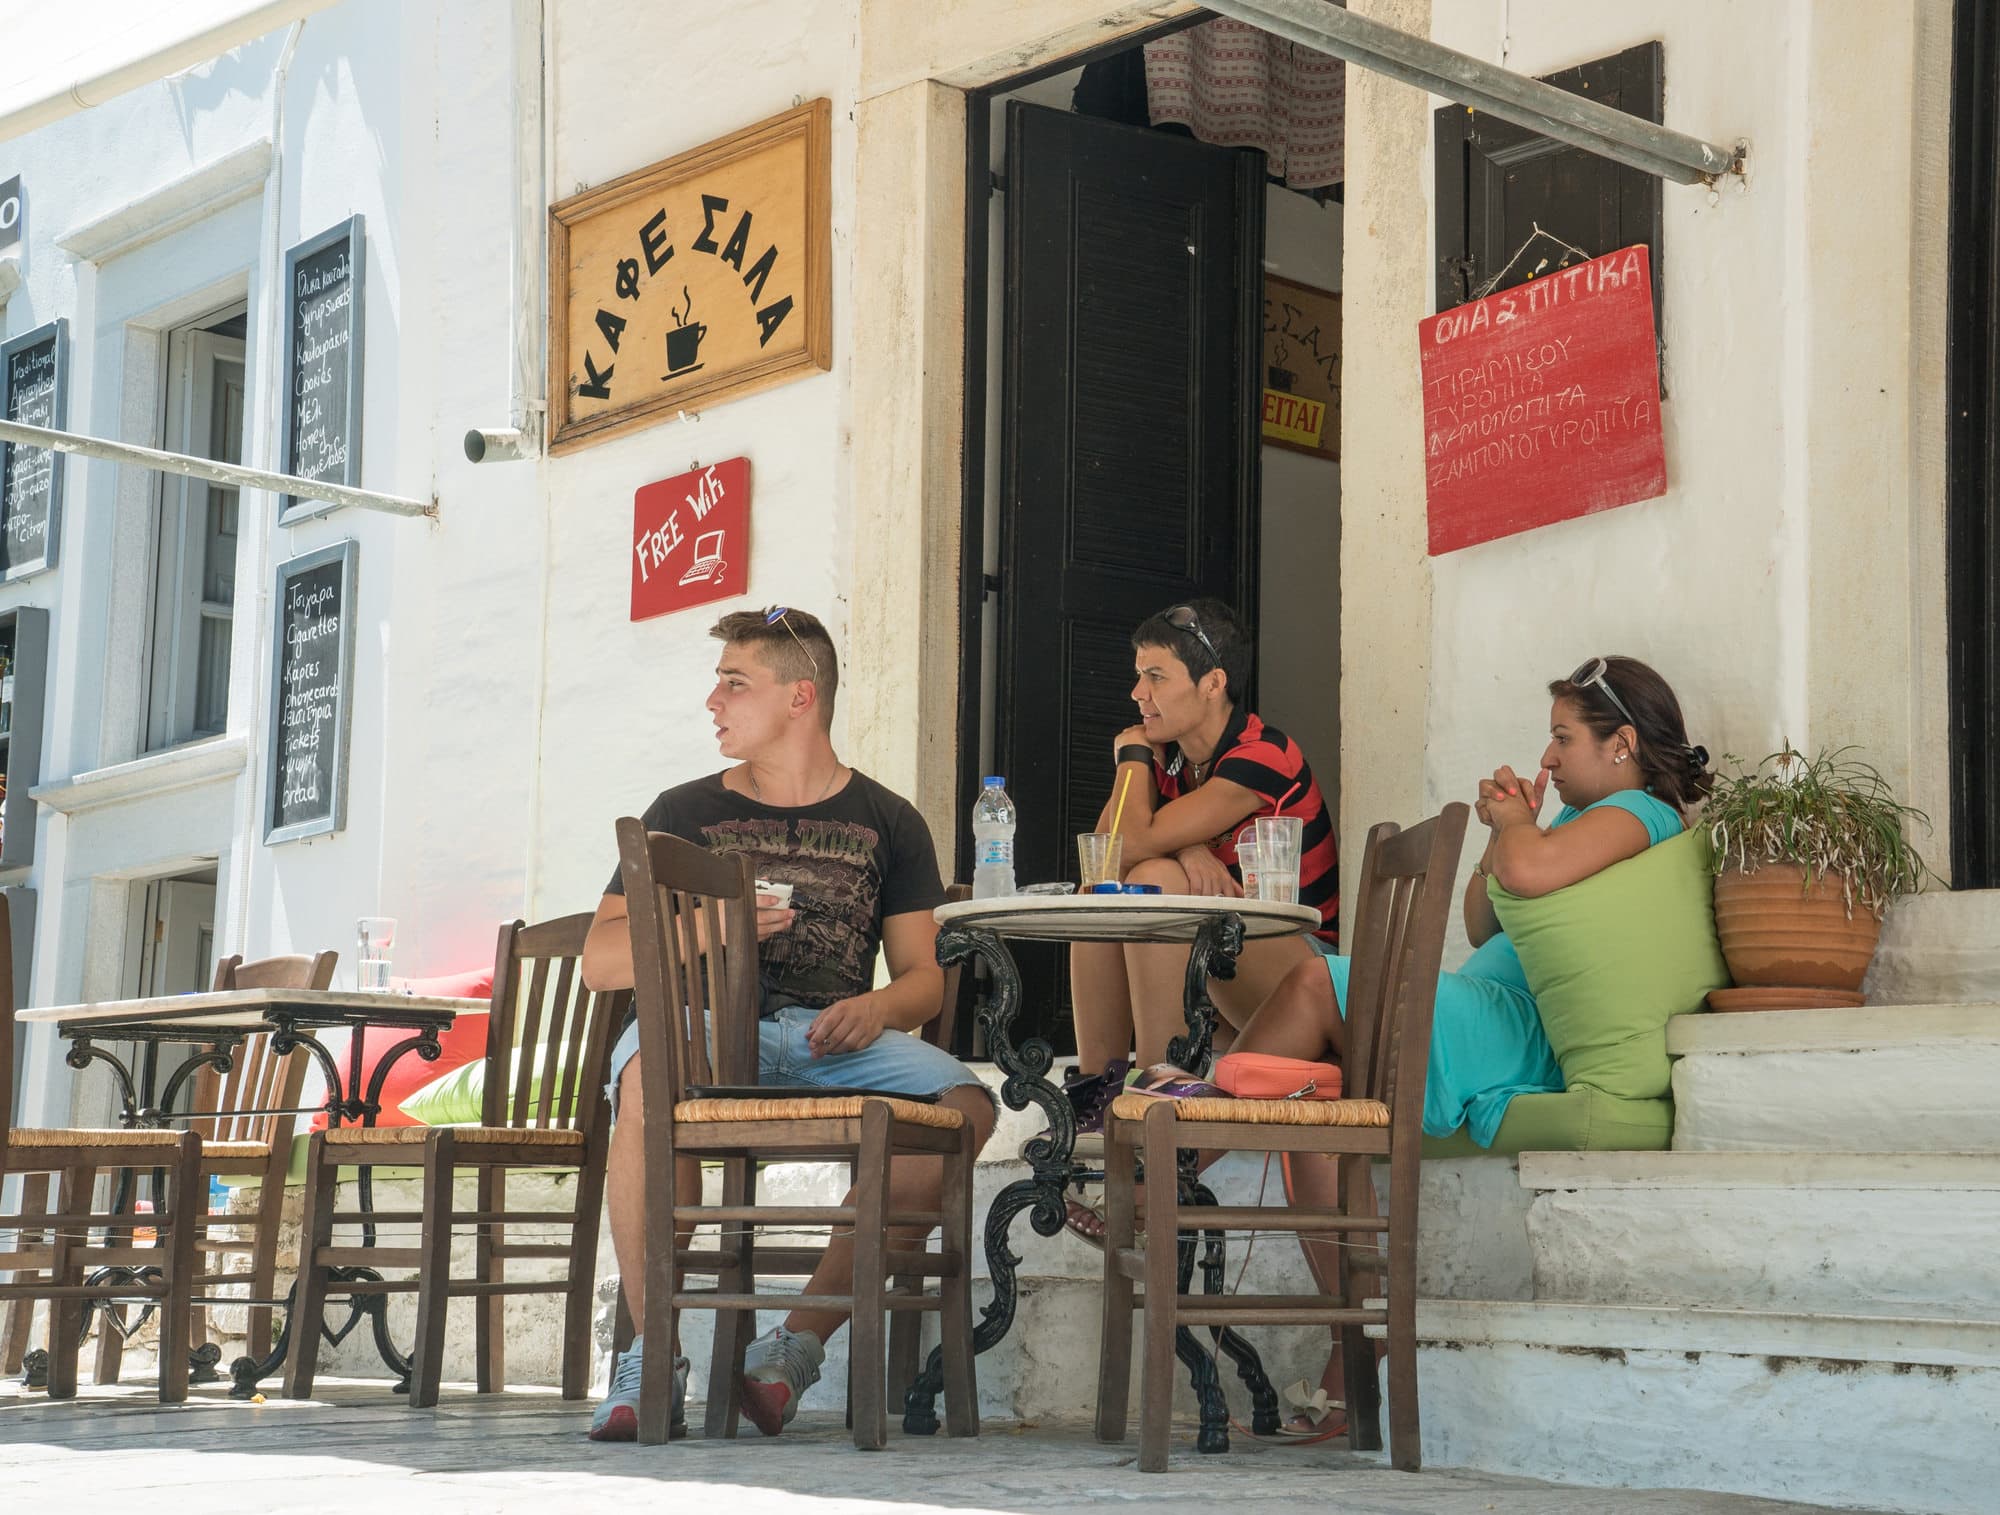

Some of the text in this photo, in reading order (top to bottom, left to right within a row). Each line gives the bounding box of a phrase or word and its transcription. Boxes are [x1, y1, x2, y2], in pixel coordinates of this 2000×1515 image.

[579, 194, 794, 400] ΚΑΦΕ ΣΑΛΑ
[298, 301, 325, 336] Syrup
[295, 367, 332, 396] Cookies
[296, 424, 328, 456] Honey
[635, 509, 684, 583] FREE
[287, 612, 338, 660] Cigarettes
